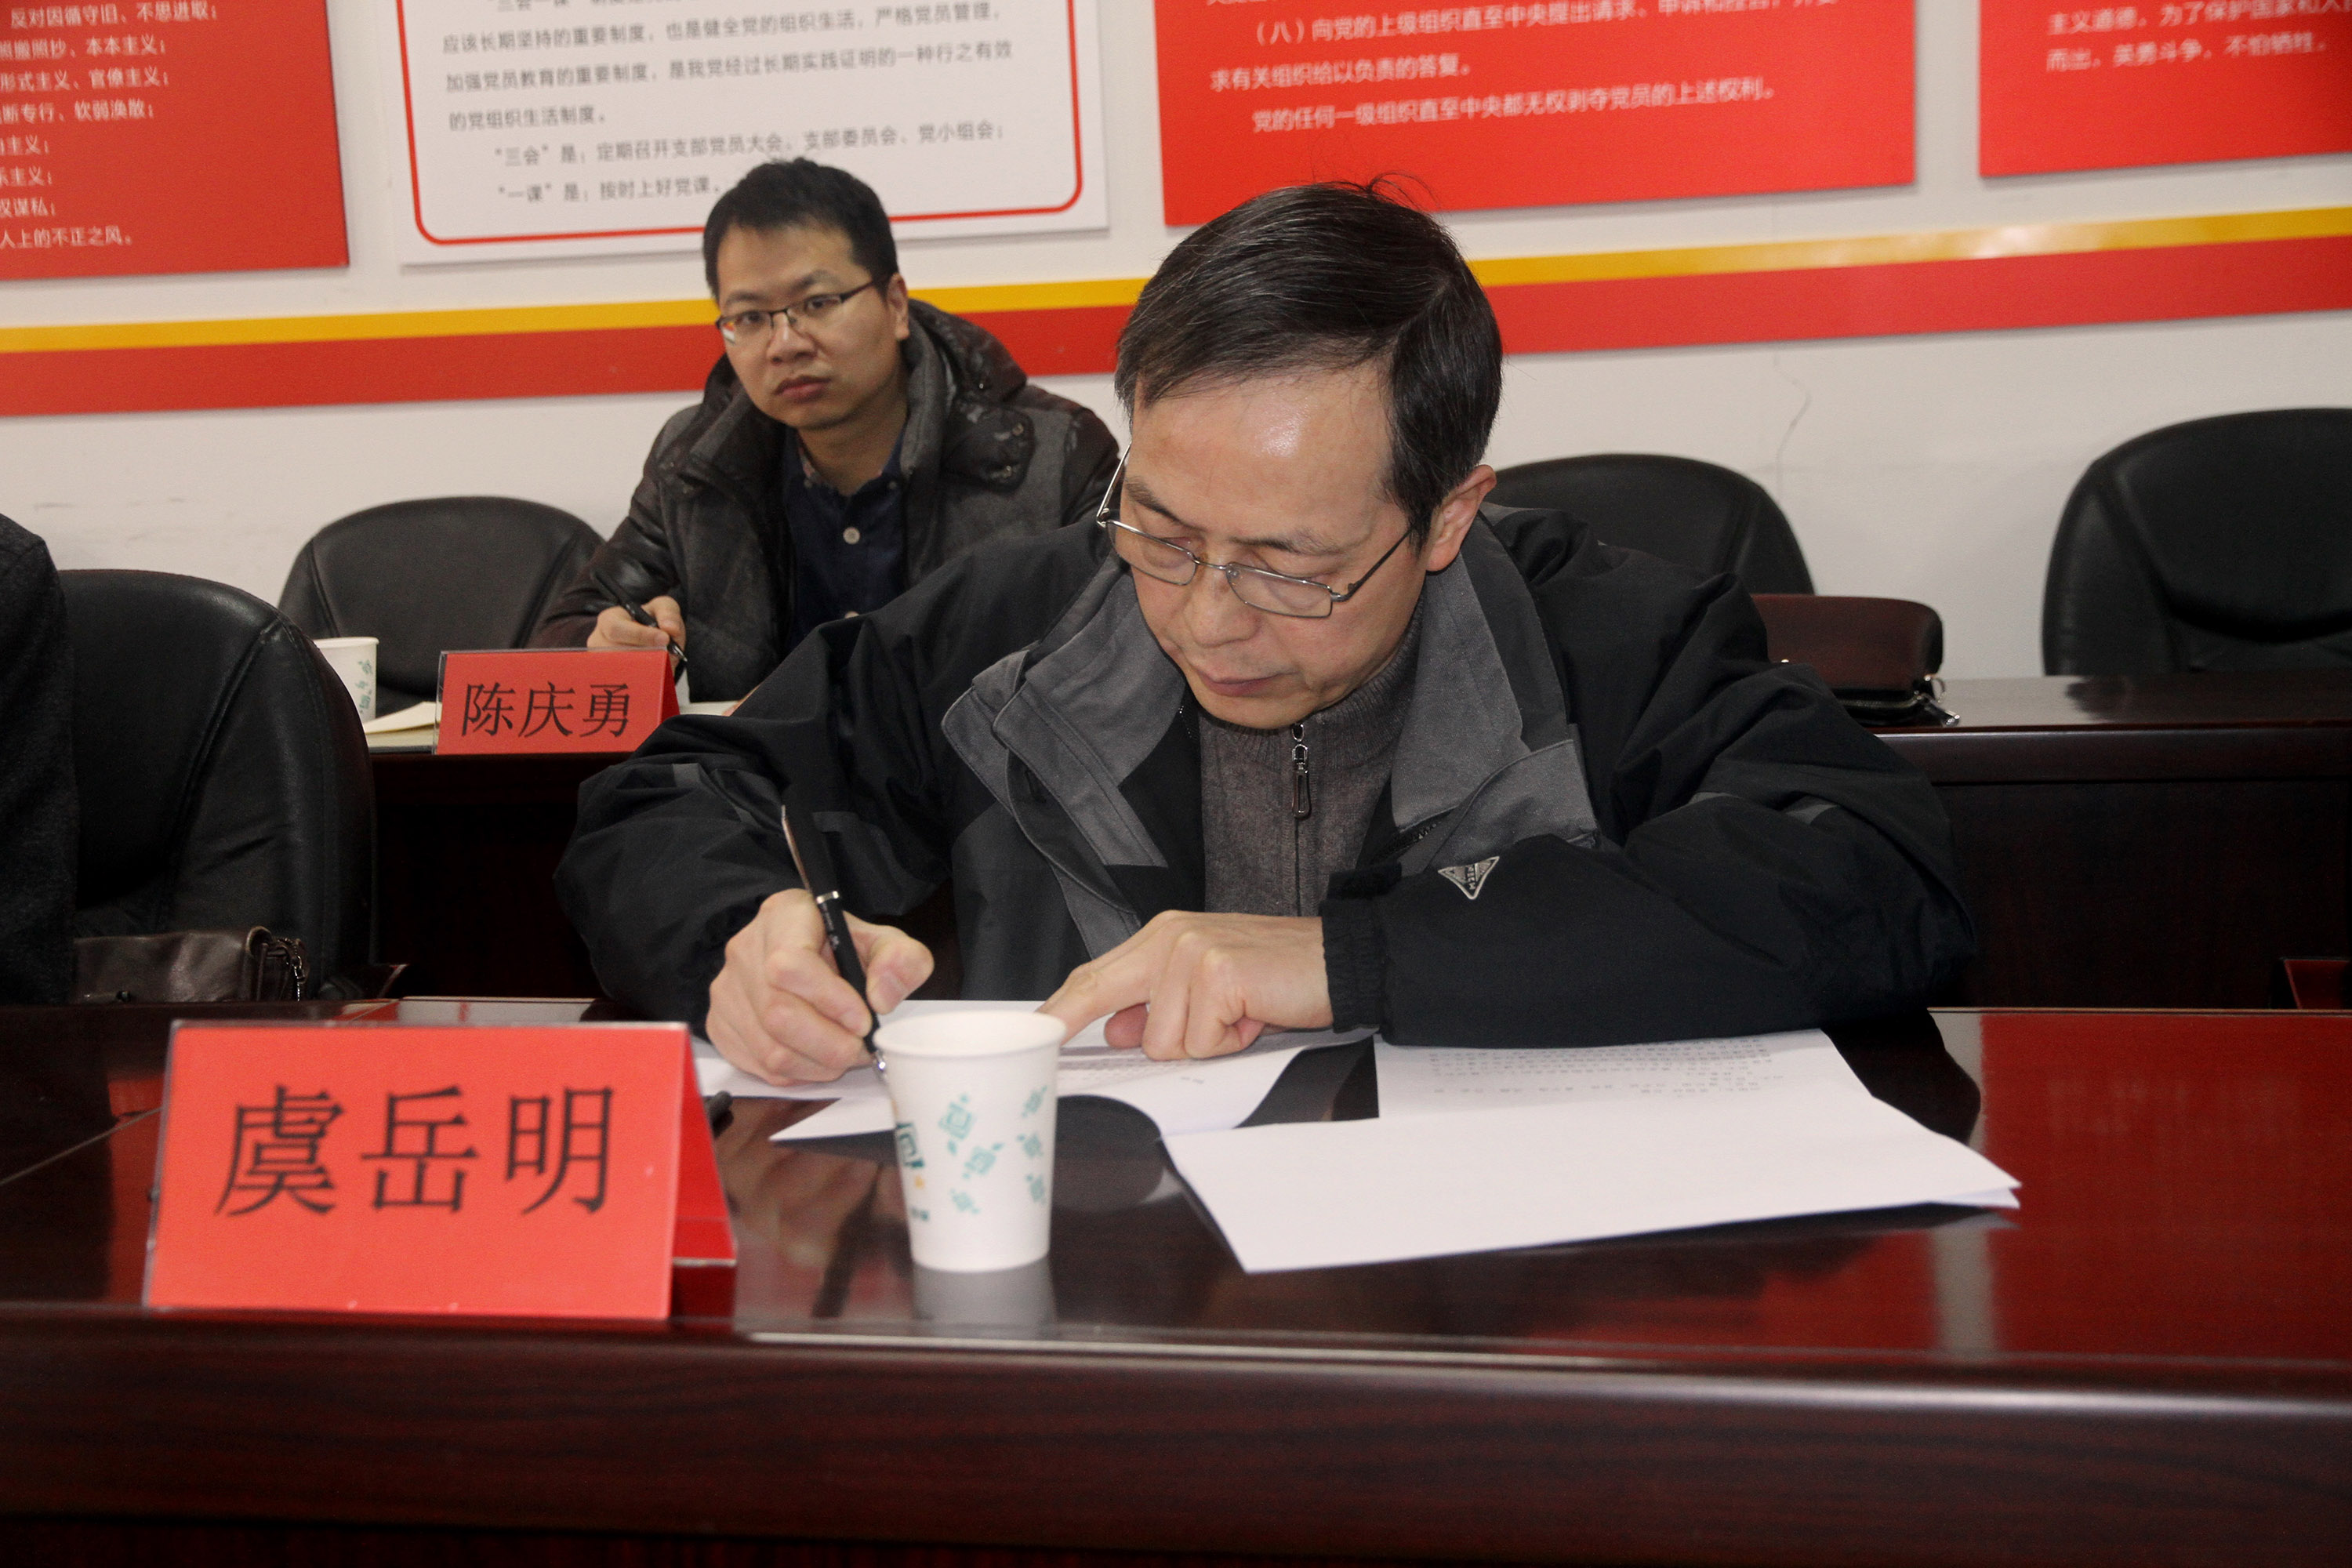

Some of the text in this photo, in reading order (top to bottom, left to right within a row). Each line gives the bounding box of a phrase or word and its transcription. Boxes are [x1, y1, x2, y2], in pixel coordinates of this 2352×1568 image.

[2046, 0, 2352, 35] 主义道德，为了保护国家和人
[0, 134, 49, 155] 主义；
[461, 681, 631, 738] 陈庆勇
[214, 1084, 614, 1216] 虞岳明
